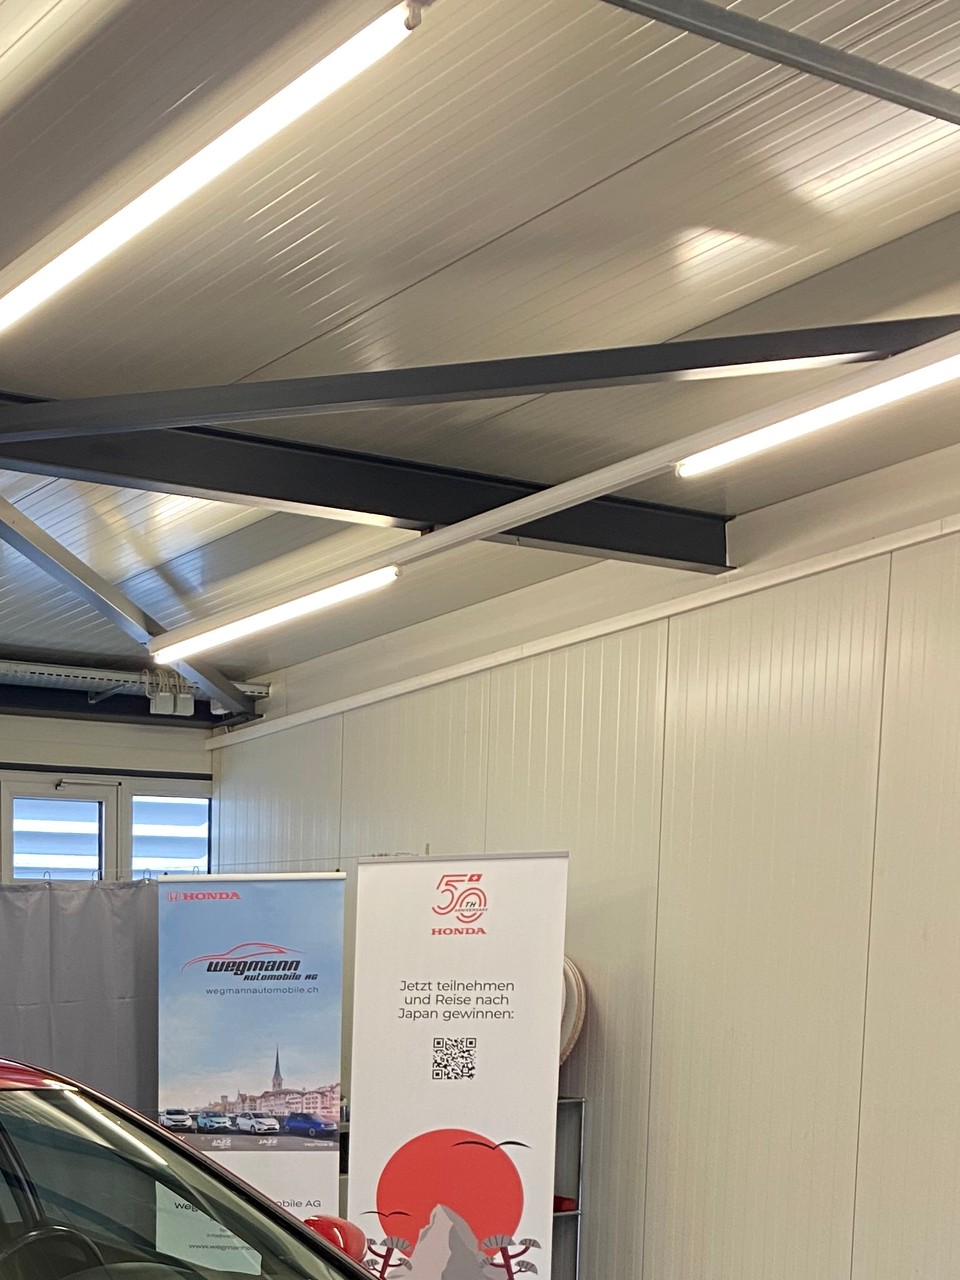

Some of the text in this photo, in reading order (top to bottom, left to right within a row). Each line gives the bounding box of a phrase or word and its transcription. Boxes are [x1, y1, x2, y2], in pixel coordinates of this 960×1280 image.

[183, 891, 241, 901] HONDA
[431, 927, 487, 936] HONDA
[206, 960, 301, 976] wegmann
[304, 973, 319, 981] AG
[399, 979, 515, 992] Jetzt teilnehmen
[205, 986, 320, 996] wegmannautomobile.ch
[404, 993, 510, 1006] und Reise nach
[398, 1007, 515, 1021] Japan gewinnen:
[305, 1200, 322, 1208] AG
